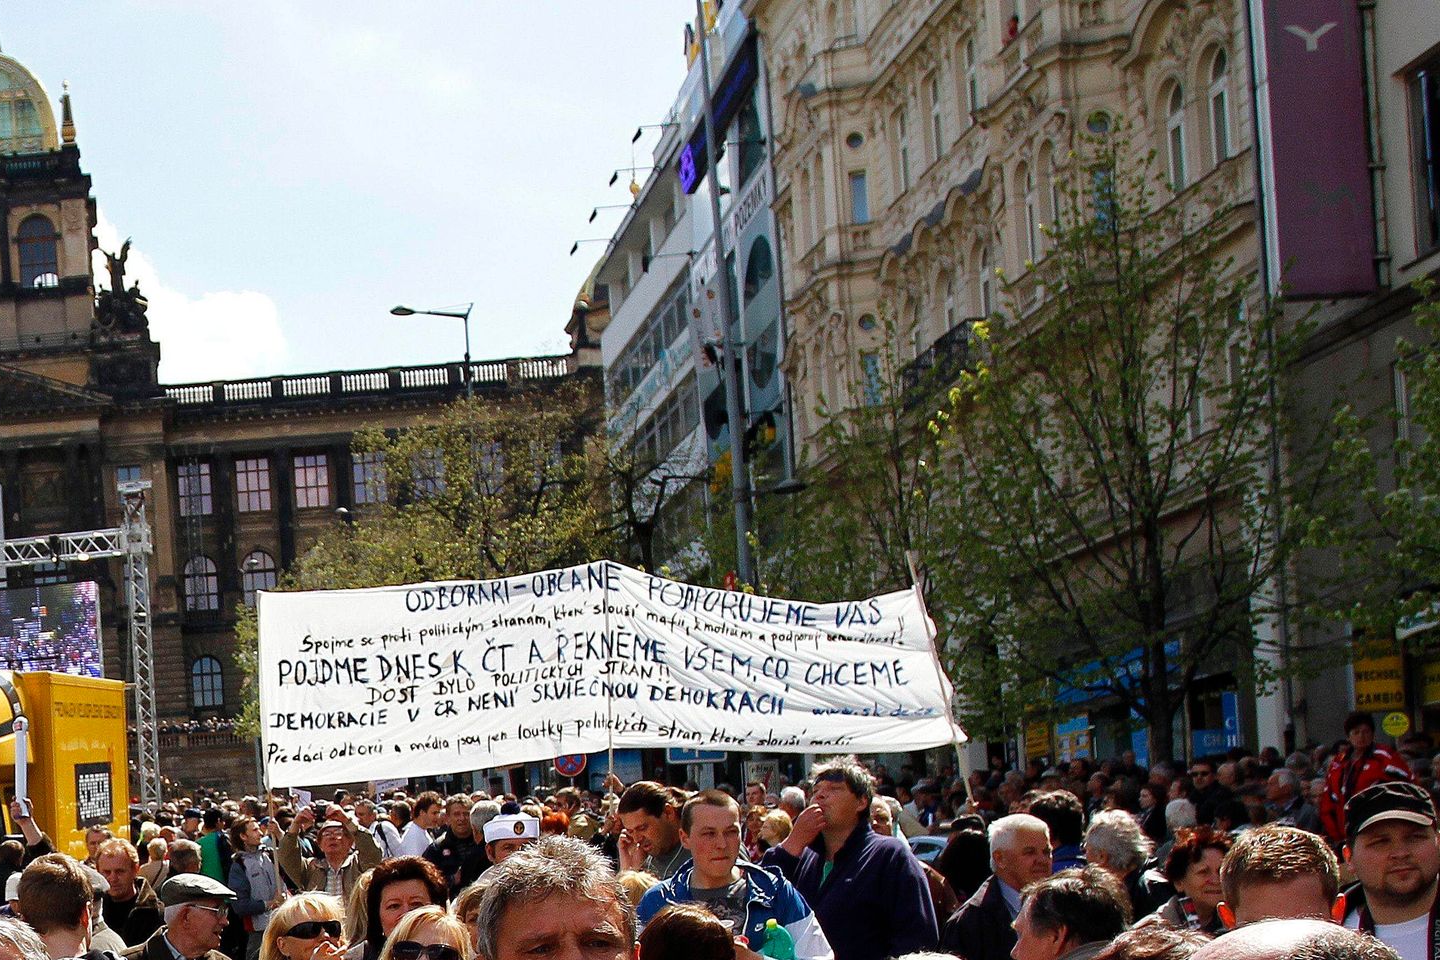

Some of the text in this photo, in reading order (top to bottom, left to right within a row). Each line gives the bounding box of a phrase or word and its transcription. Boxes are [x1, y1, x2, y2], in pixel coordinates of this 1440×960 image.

[299, 634, 354, 654] Spojme
[361, 636, 375, 646] se
[381, 627, 412, 649] proti
[418, 618, 484, 645] politickým
[375, 652, 442, 683] DNES
[452, 649, 473, 677] K
[481, 637, 515, 673] ČT
[528, 639, 545, 665] A
[804, 659, 909, 689] CHCEME
[269, 708, 389, 731] DEMOKRACIE
[407, 707, 420, 723] V
[467, 686, 519, 712] NENÍ
[364, 684, 420, 706] DOST
[432, 678, 476, 696] BYLO
[1356, 691, 1404, 705] CAMBIO
[457, 734, 481, 755] jsou
[518, 720, 564, 743] loutky
